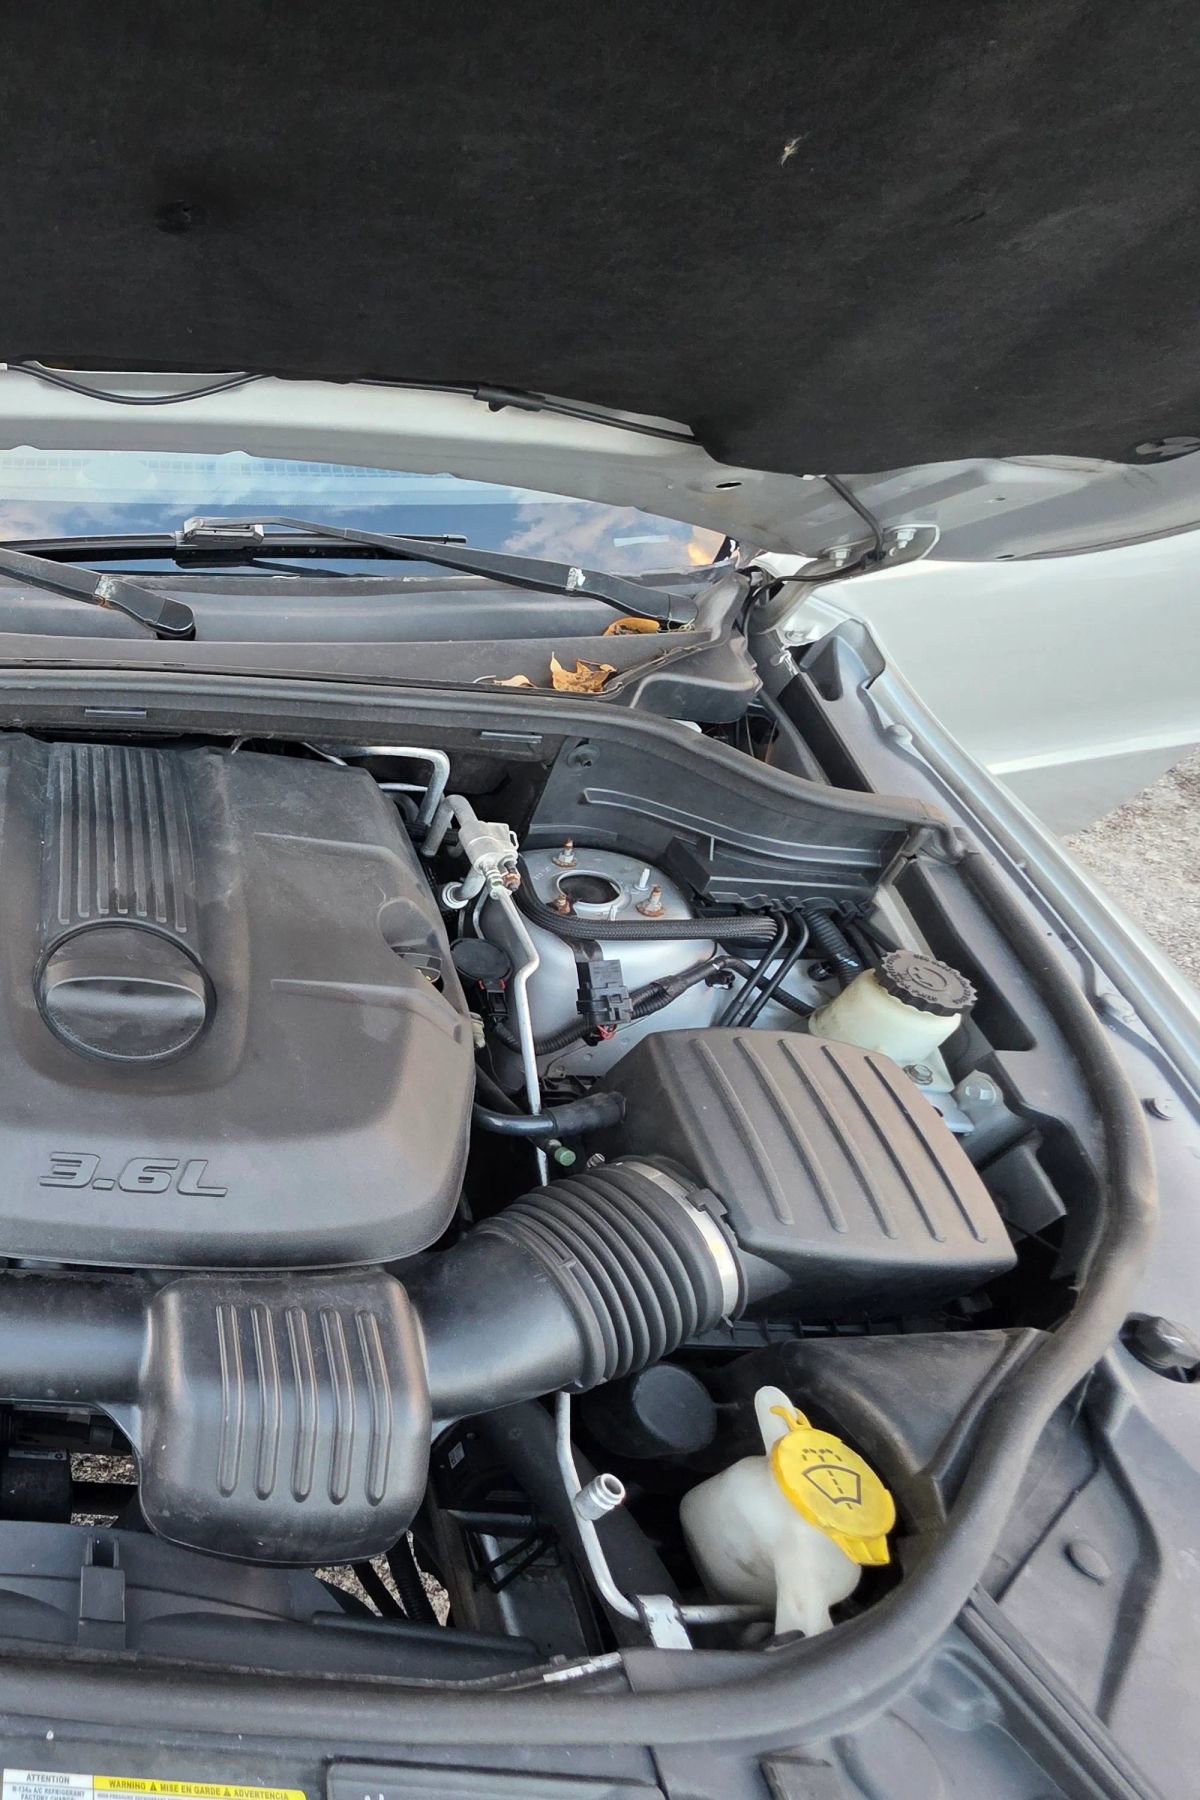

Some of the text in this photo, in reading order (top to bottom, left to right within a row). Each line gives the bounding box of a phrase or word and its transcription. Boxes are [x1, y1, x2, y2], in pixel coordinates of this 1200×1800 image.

[39, 1151, 229, 1198] 3.6L
[26, 1773, 70, 1785] ATTENTION
[108, 1779, 289, 1800] WARNING MISE EN GARDE ADVERTENCIA
